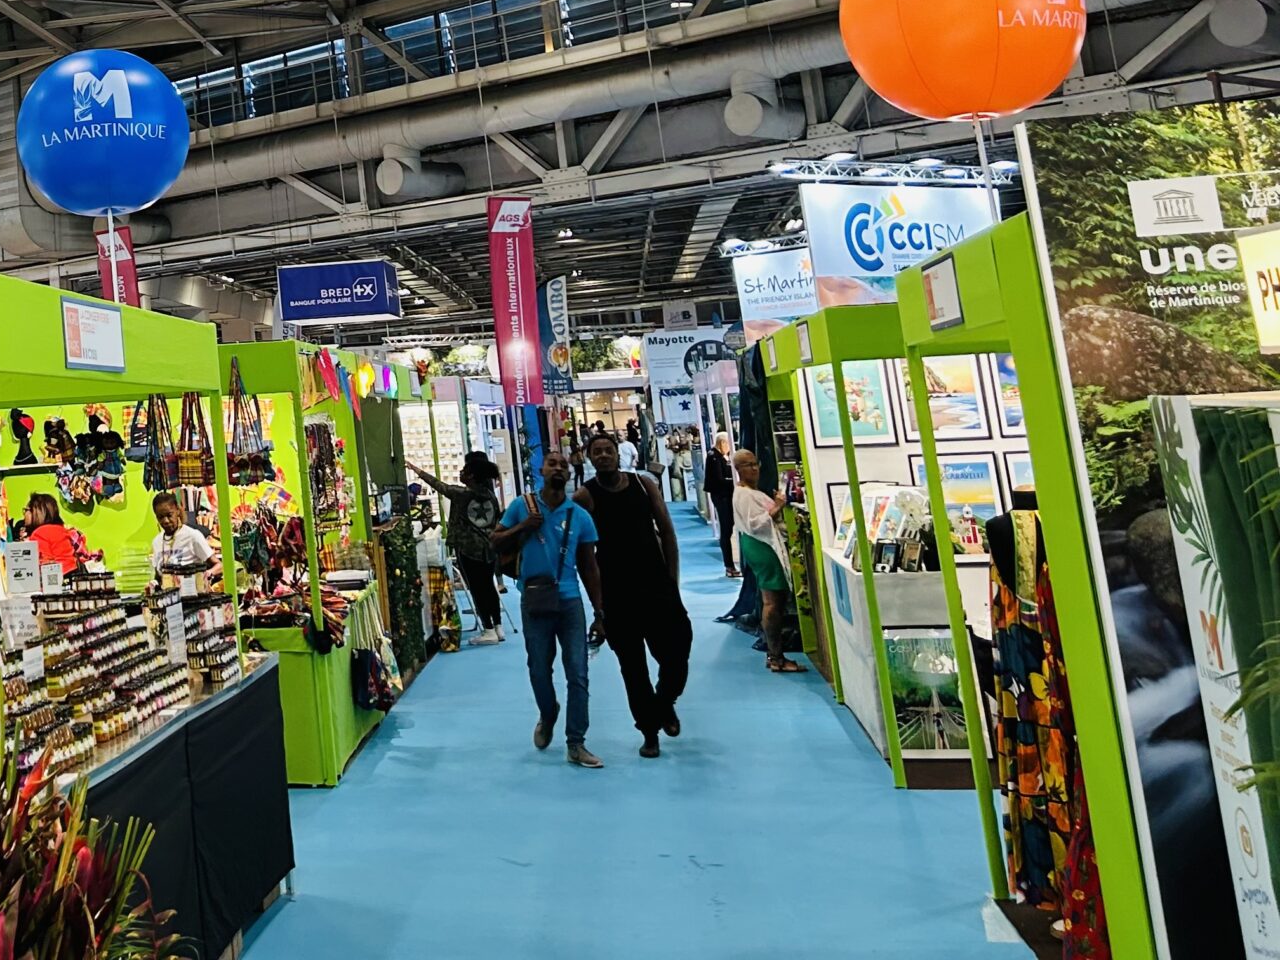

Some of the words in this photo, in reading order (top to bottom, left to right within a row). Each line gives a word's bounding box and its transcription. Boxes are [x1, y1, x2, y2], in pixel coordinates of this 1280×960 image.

[998, 9, 1026, 28] LA
[42, 131, 61, 147] LA
[64, 122, 167, 141] MARTINIQUE
[499, 214, 520, 223] AGS
[506, 237, 518, 312] Internationaux
[320, 288, 351, 298] BRED
[1146, 284, 1198, 297] Réserve
[1200, 282, 1217, 293] de
[317, 297, 352, 305] POPULAIRE
[1149, 297, 1167, 309] de
[1168, 293, 1241, 307] Martinique
[648, 335, 695, 347] Mayotte
